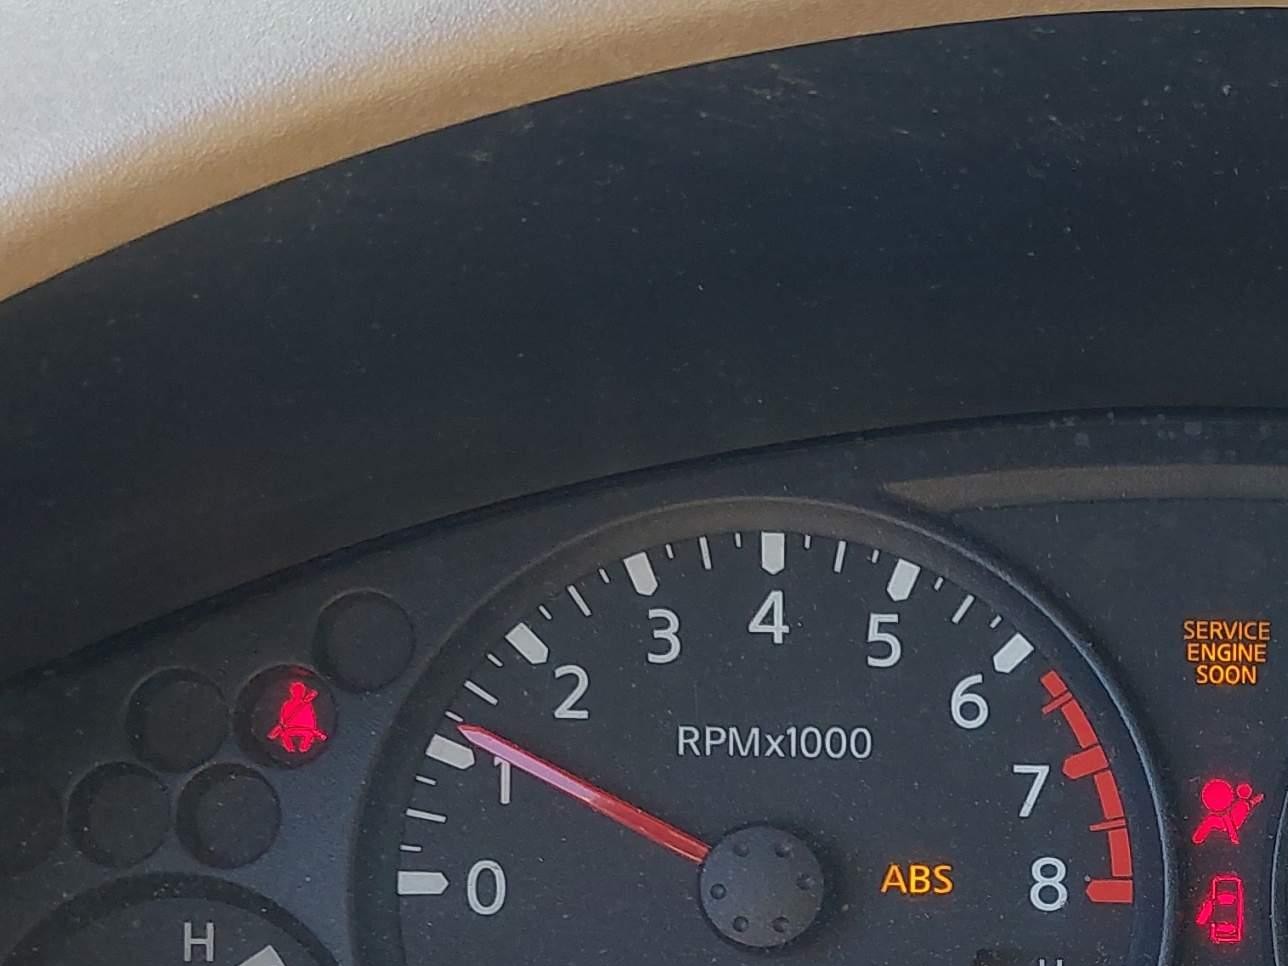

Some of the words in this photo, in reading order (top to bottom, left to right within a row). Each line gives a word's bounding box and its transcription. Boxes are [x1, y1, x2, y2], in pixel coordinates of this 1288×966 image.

[648, 609, 681, 664] 3
[748, 590, 789, 644] 4
[866, 614, 901, 667] 5
[1183, 620, 1271, 641] SERVICE
[1187, 642, 1267, 663] ENGINE
[1196, 665, 1257, 685] SOON
[553, 666, 590, 720] 2
[951, 675, 988, 729] 6
[677, 725, 872, 759] RPMx1000
[494, 757, 511, 805] 1
[1012, 765, 1050, 817] 7
[466, 860, 507, 915] 0
[881, 865, 953, 895] ABS
[1030, 858, 1068, 911] 8
[184, 922, 214, 962] H
